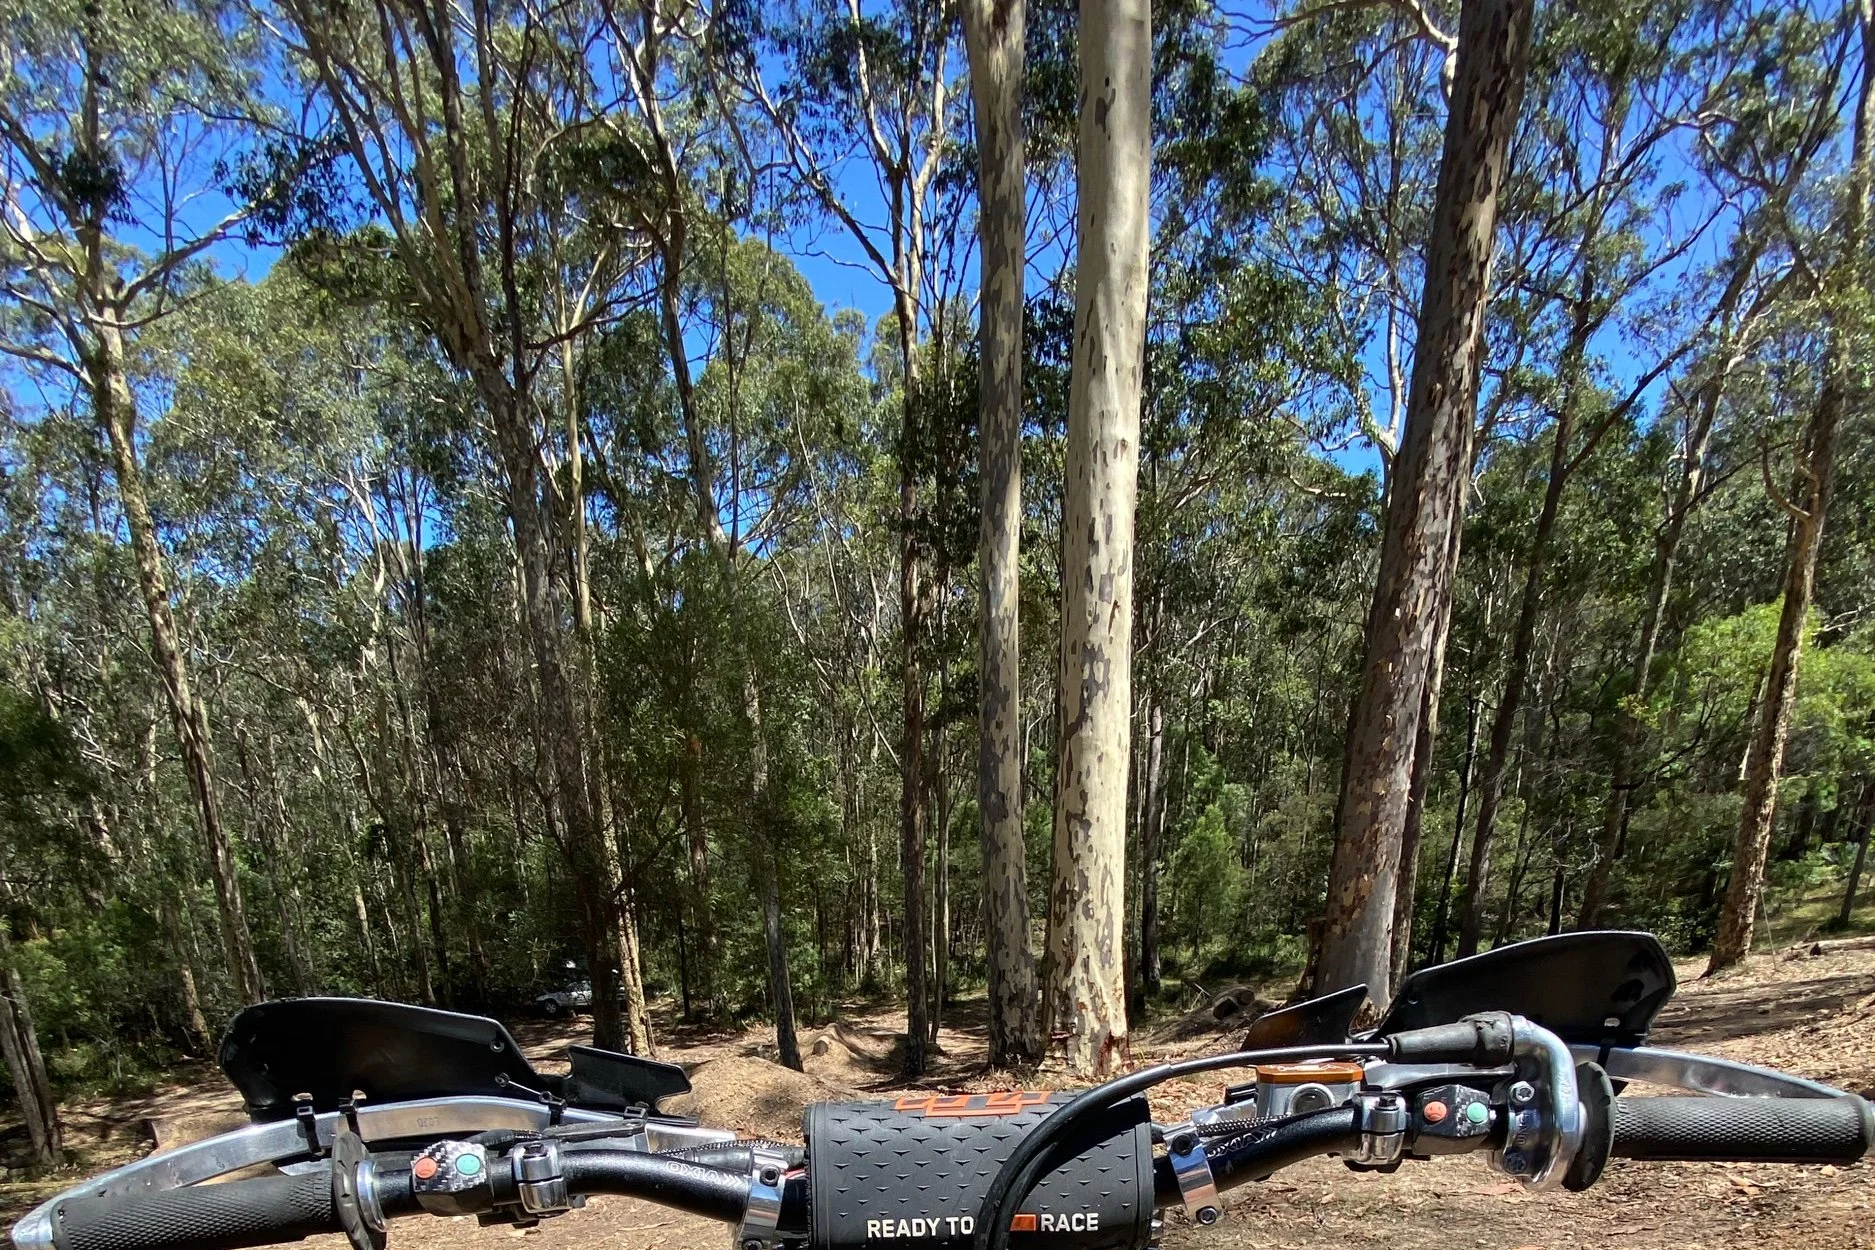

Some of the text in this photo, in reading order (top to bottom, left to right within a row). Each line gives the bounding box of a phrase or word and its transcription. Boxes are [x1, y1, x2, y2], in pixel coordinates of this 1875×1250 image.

[867, 1212, 1099, 1238] READY TO RACE
